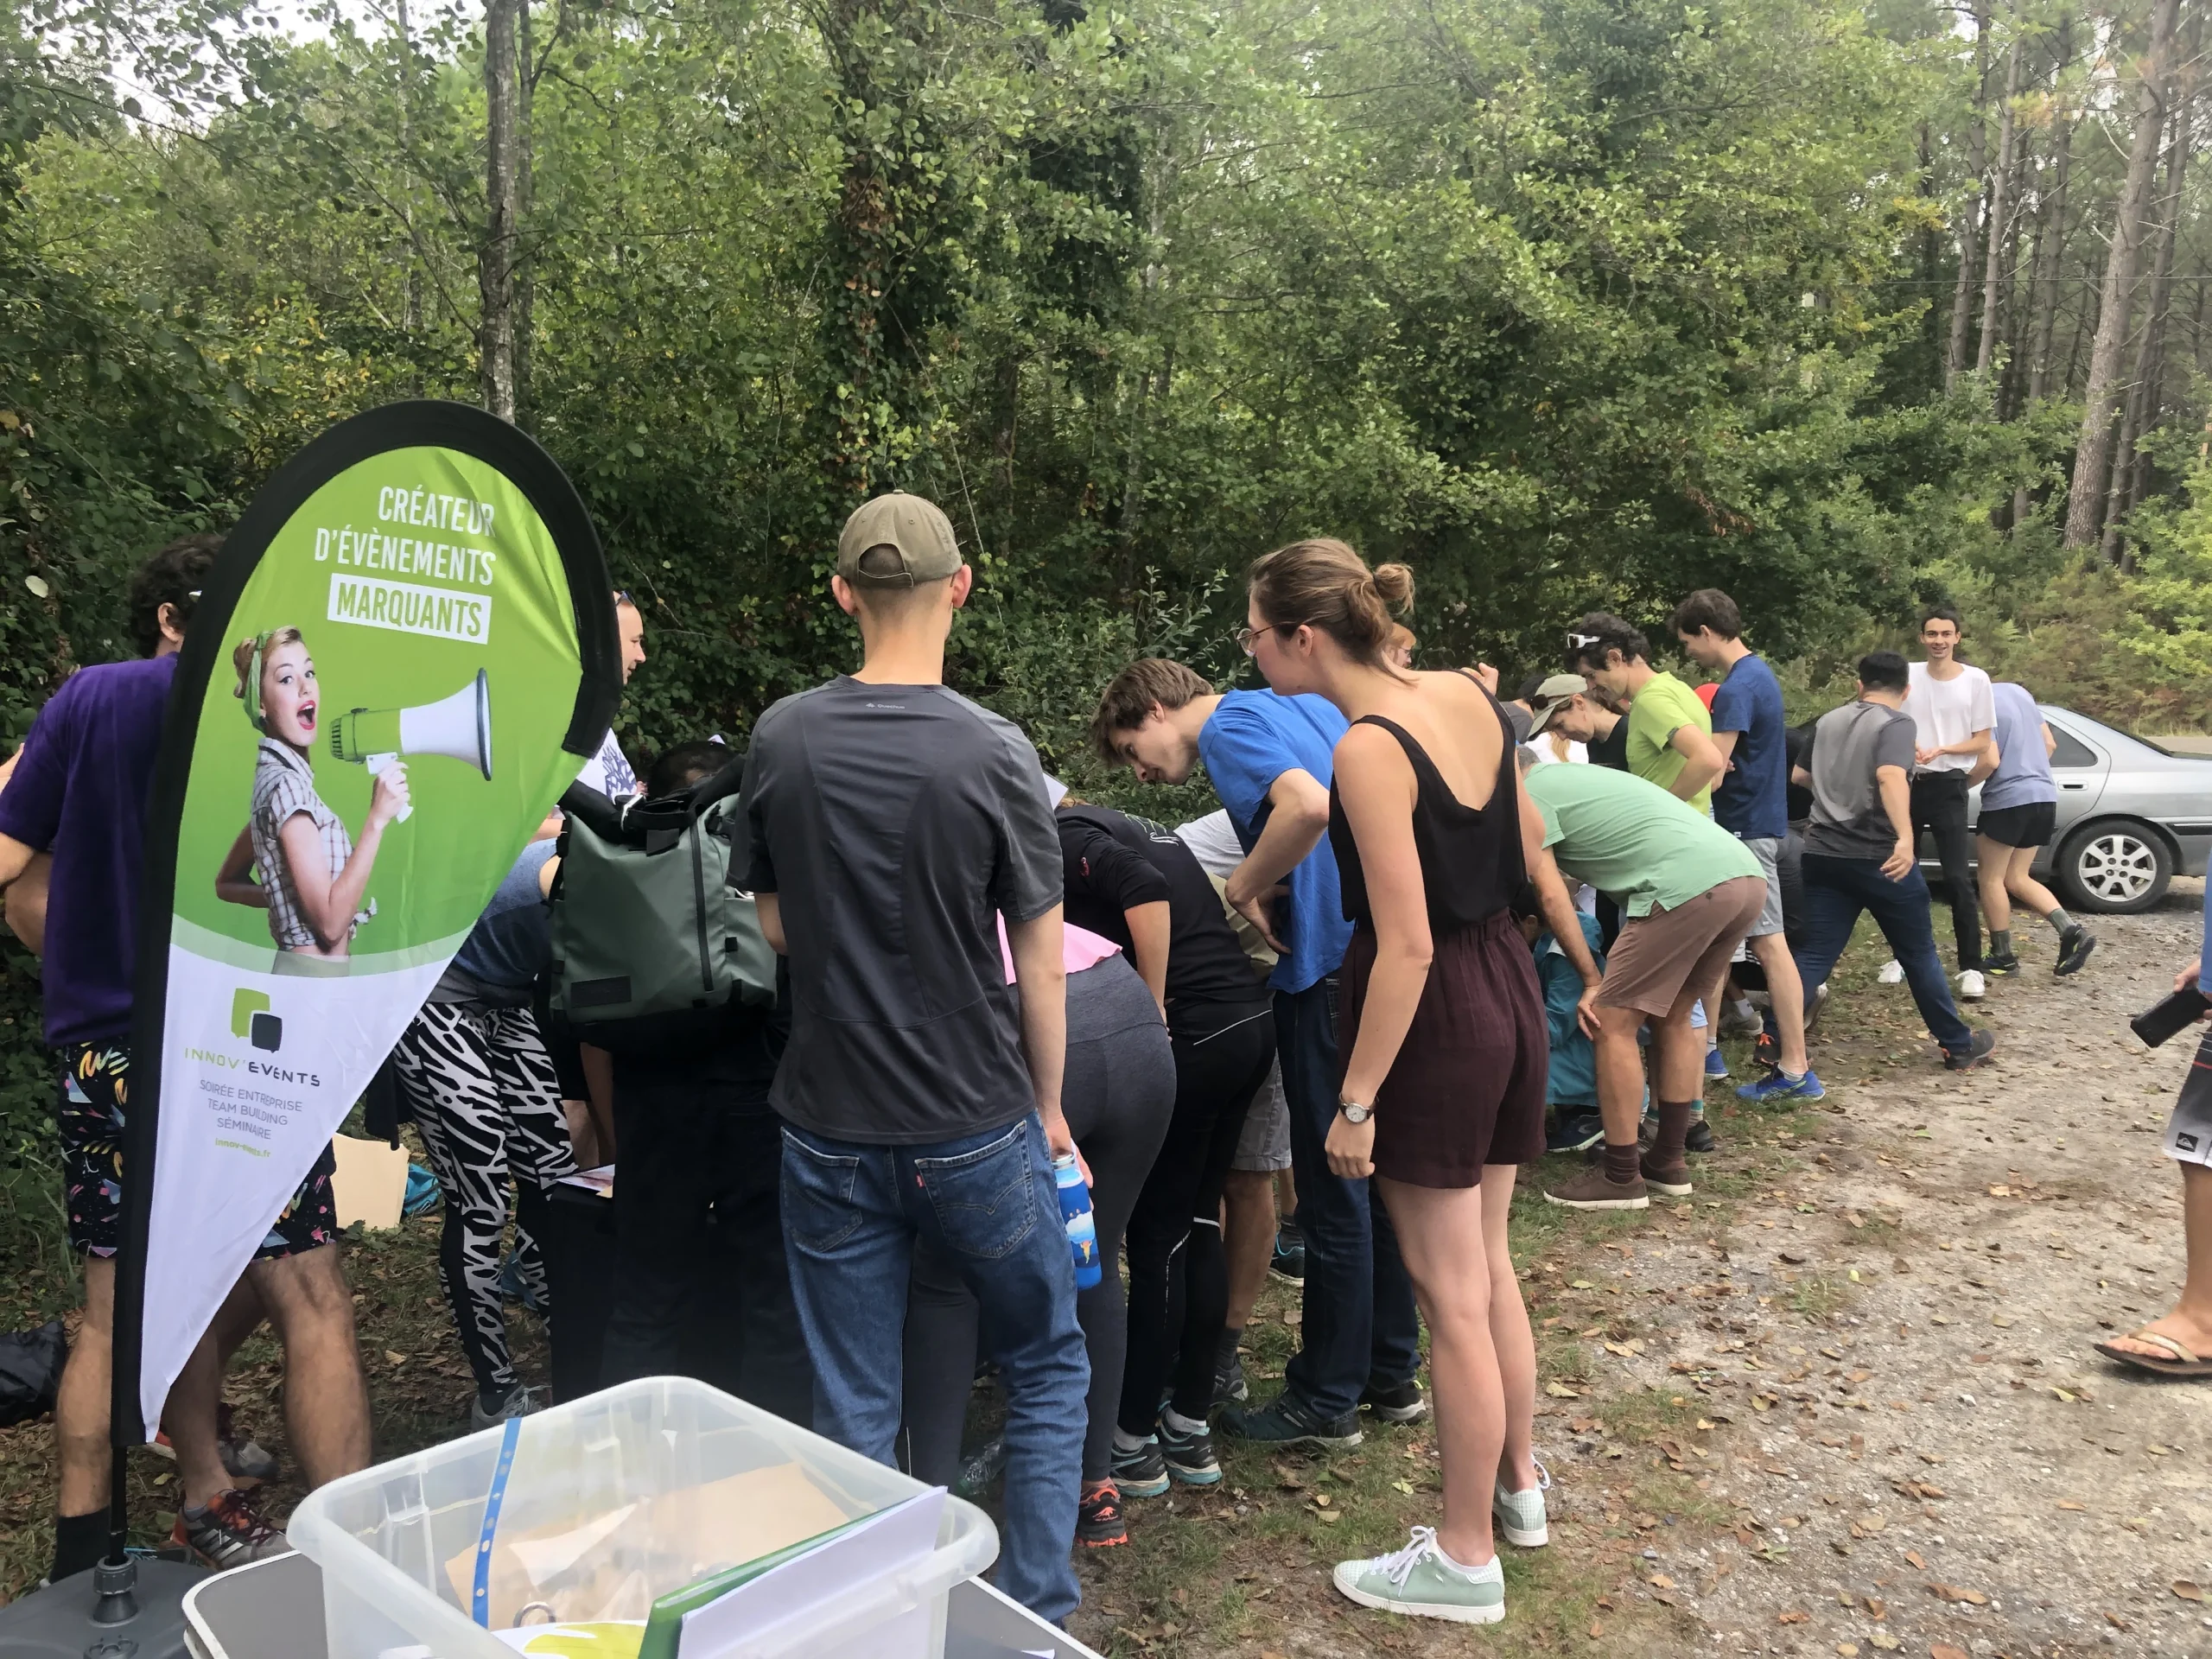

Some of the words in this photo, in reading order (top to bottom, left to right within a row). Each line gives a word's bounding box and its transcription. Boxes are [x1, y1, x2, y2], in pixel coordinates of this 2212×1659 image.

[378, 484, 496, 537] CRÉATEUR
[335, 582, 483, 638] MARQUANTS
[200, 1078, 234, 1098] SOIRÉE
[238, 1088, 303, 1112] ENTREPRISE
[207, 1097, 237, 1115] TEAM
[240, 1105, 289, 1126] BUILDING
[217, 1116, 272, 1141] SÉMINAIRE
